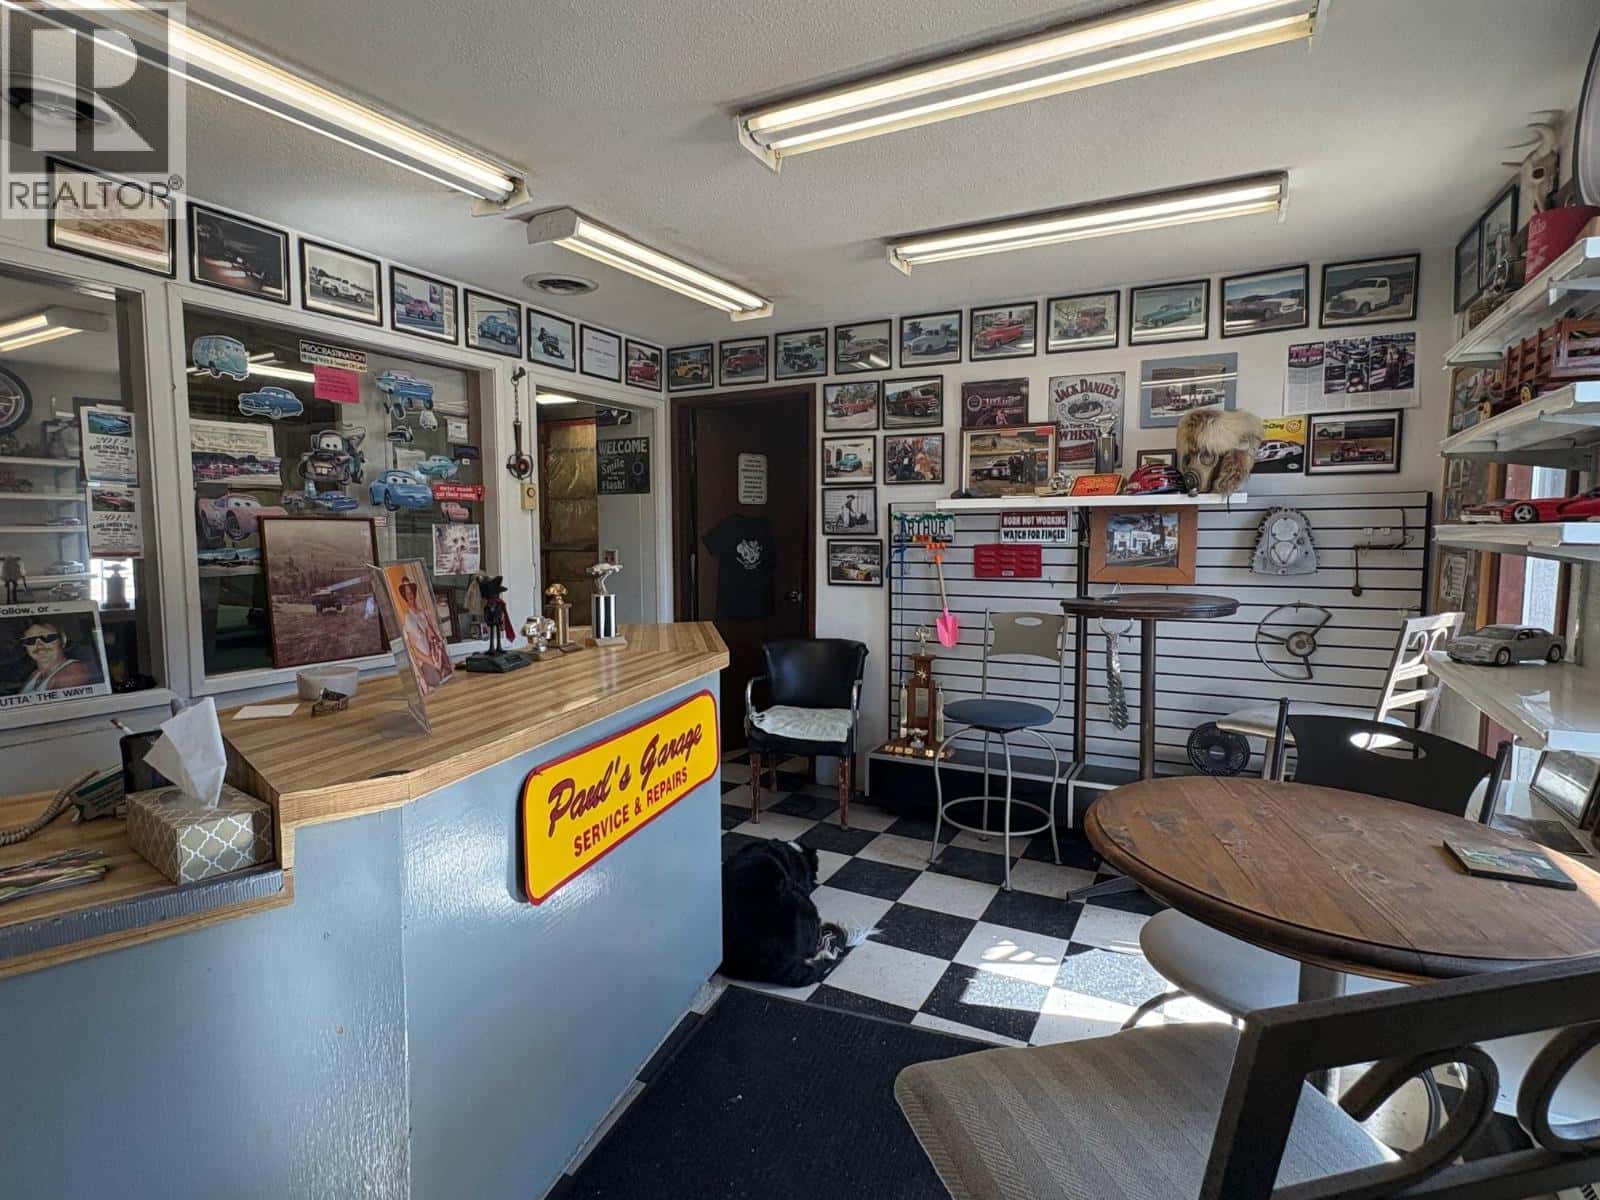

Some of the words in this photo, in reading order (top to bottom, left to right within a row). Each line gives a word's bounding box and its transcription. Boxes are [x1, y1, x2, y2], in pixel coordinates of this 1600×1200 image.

[301, 343, 366, 363] PROCRASTINATION
[1054, 384, 1079, 403] JACK
[1079, 378, 1120, 399] DANIEL'S
[599, 440, 648, 456] WELCOME
[601, 458, 625, 474] Smile
[901, 518, 946, 536] ARTHUR
[1022, 515, 1035, 525] NOT
[1035, 515, 1066, 526] WORKING
[1003, 529, 1027, 540] WATCH
[1027, 529, 1041, 540] FOR
[1041, 529, 1066, 540] FINGER
[36, 693, 57, 702] THE
[547, 755, 632, 838] Paul's
[640, 723, 703, 791] Garage
[574, 804, 630, 858] SERVICE
[634, 797, 642, 816] &
[646, 766, 688, 806] REPAIRS
